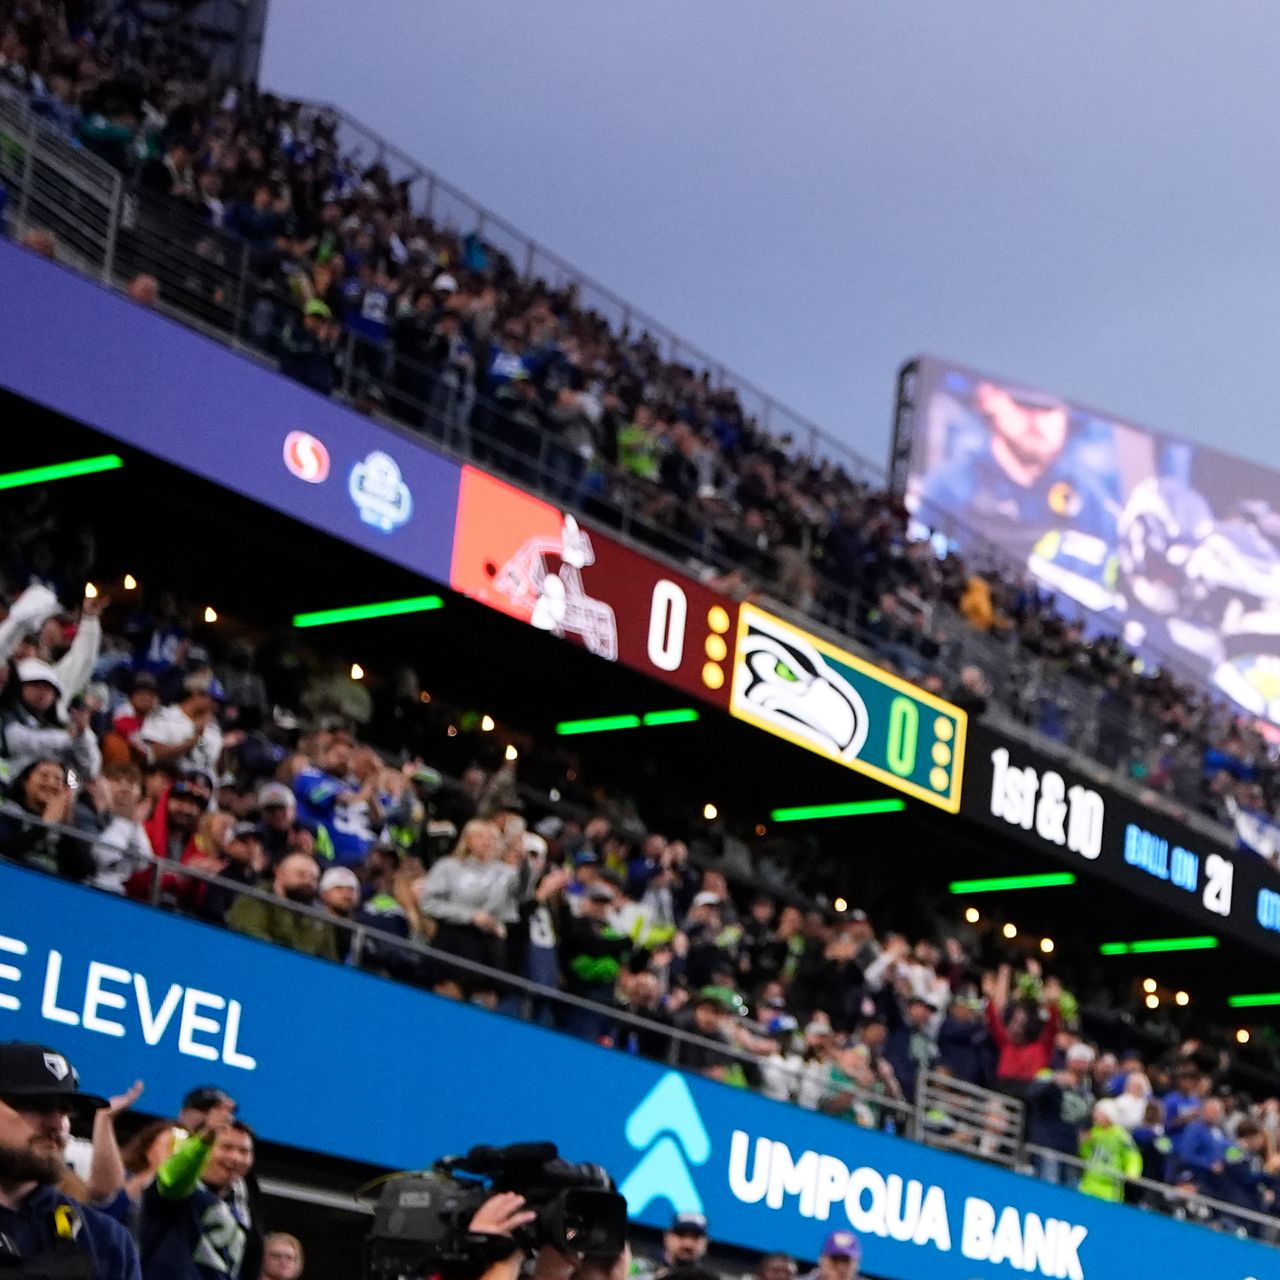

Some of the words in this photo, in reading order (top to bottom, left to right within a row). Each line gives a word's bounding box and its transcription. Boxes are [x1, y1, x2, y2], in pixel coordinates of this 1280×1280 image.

[648, 579, 688, 672] 0
[887, 697, 919, 777] 0
[991, 747, 1039, 830] 1st
[1036, 770, 1067, 846] &
[1066, 784, 1105, 859] 10
[1123, 822, 1170, 881] BALL
[1203, 854, 1233, 917] 21
[41, 949, 257, 1070] LEVEL
[728, 1129, 952, 1252] UMPQUA
